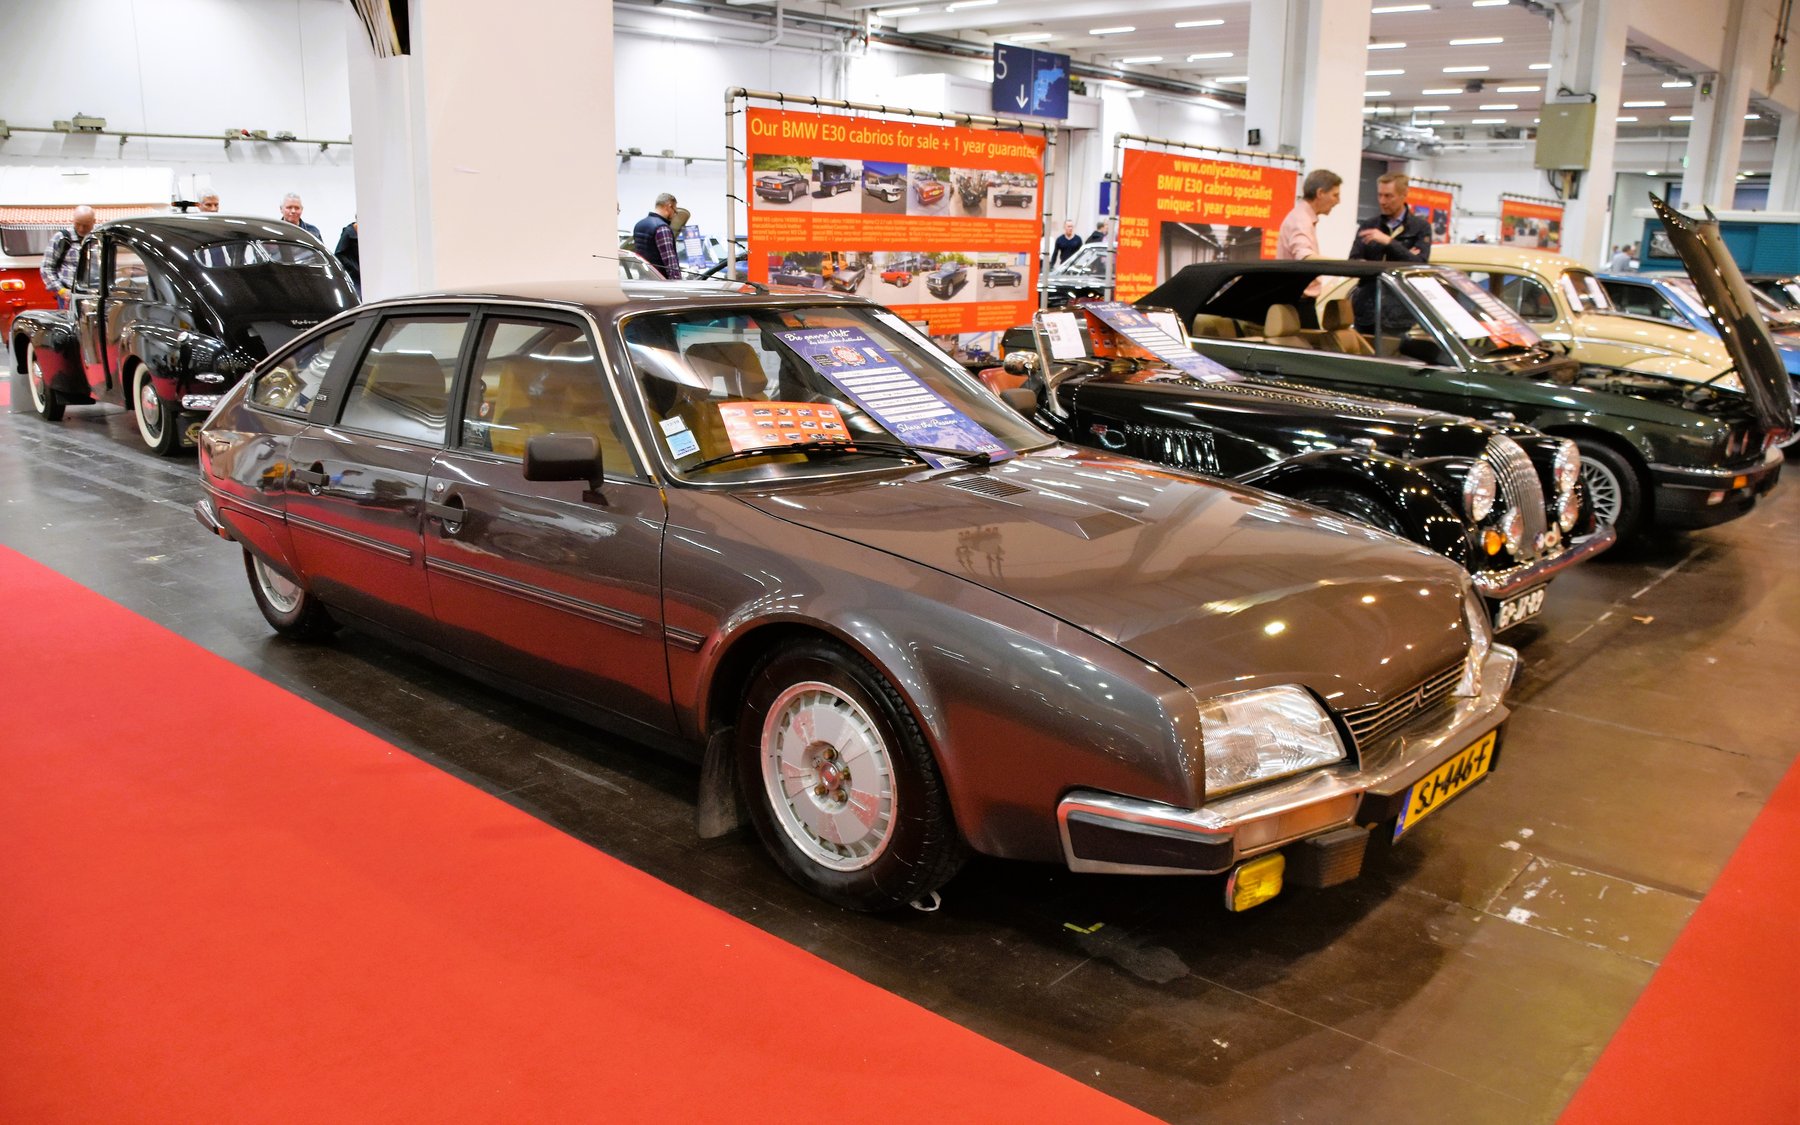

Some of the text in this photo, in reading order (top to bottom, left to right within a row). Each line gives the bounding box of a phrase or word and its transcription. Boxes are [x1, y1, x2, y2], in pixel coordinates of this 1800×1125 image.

[996, 50, 1007, 80] 5
[751, 118, 778, 137] Our
[782, 120, 818, 140] BMW
[822, 124, 846, 143] E30
[849, 128, 894, 147] cabrios
[897, 131, 914, 148] for
[917, 133, 940, 150] sale
[942, 140, 950, 150] +
[954, 137, 960, 152] 1
[963, 141, 985, 156] year
[1174, 160, 1262, 181] www.onlycabrios.nl
[1158, 175, 1273, 202] BMW E30 cabrio specialist
[1157, 195, 1272, 220] unique: 1 year guarantee!
[784, 332, 803, 342] Die
[827, 329, 851, 339] Welt
[1414, 738, 1490, 815] SJ-446-F
